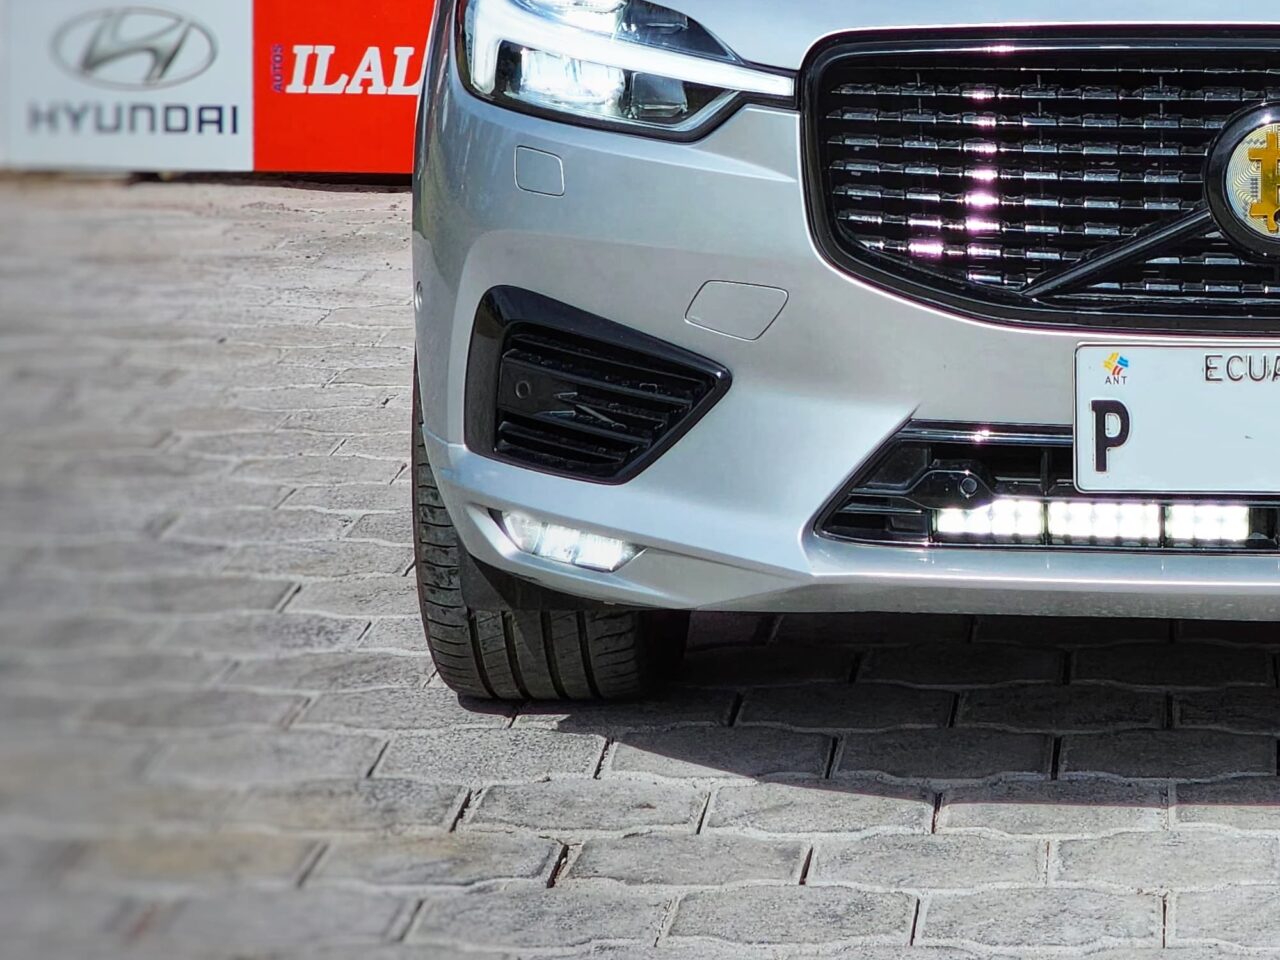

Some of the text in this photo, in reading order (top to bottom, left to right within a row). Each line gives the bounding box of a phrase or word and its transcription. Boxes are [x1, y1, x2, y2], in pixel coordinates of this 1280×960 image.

[27, 103, 239, 136] HYUNDAI
[1105, 376, 1128, 385] ANT
[1091, 399, 1131, 472] P
